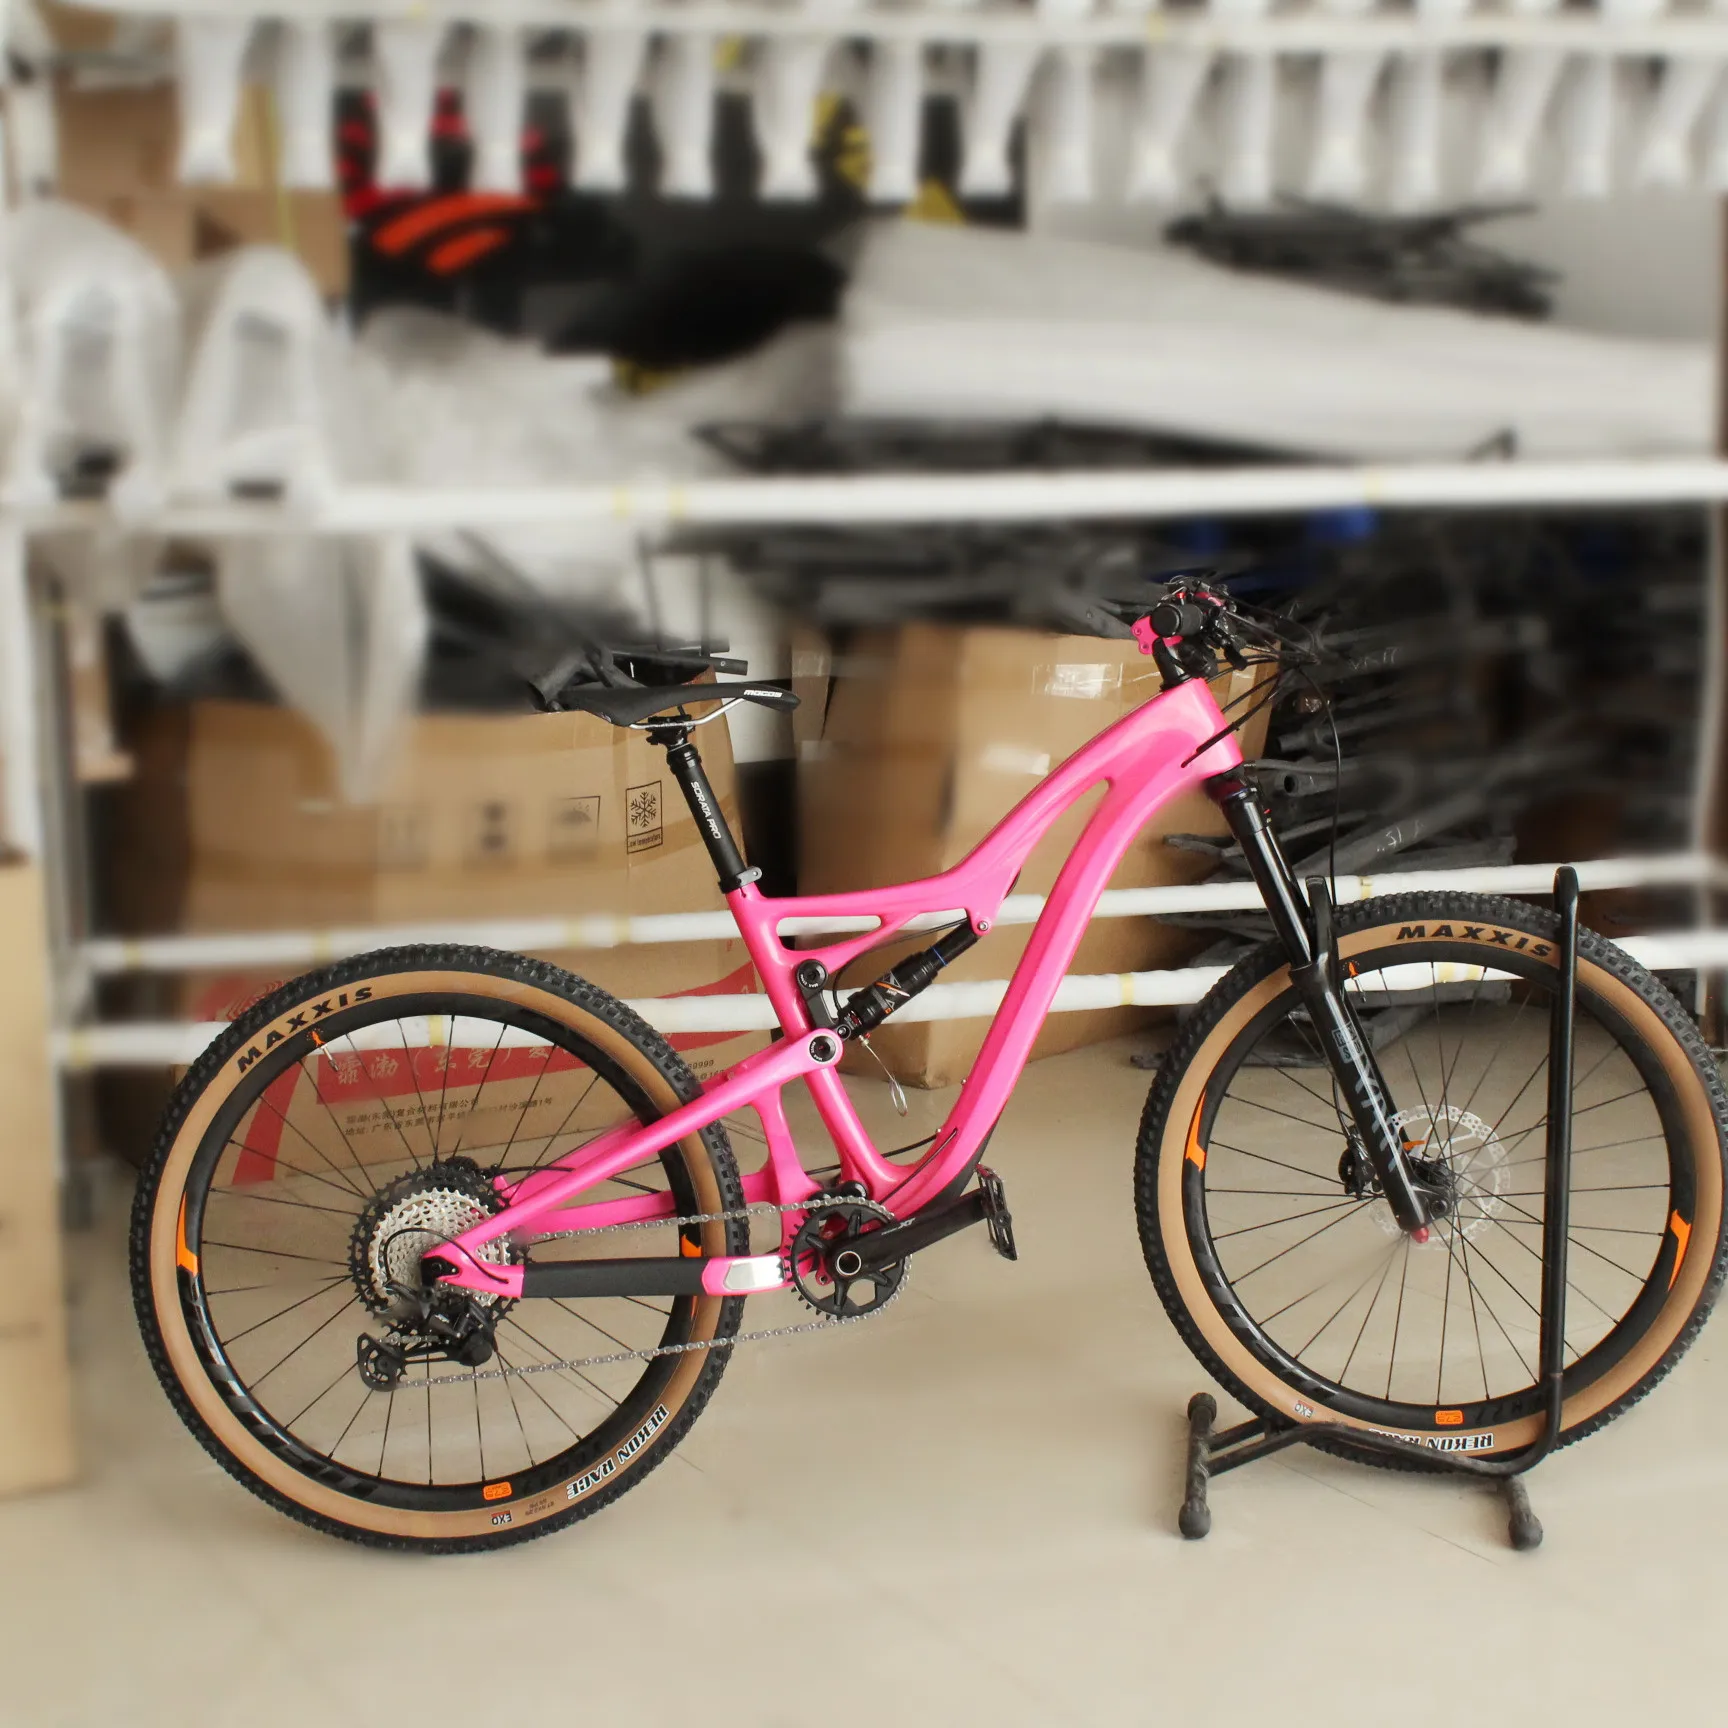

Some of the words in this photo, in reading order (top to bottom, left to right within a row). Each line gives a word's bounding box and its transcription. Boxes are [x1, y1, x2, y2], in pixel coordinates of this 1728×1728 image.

[691, 781, 712, 818] SORATA
[706, 818, 722, 839] PRO
[1396, 924, 1552, 958] MAXXIS
[236, 986, 373, 1074] MAXXIS
[617, 1403, 671, 1465] REKON
[1425, 1431, 1495, 1452] REKON
[566, 1457, 617, 1500] RACE
[491, 1512, 513, 1526] EXO
